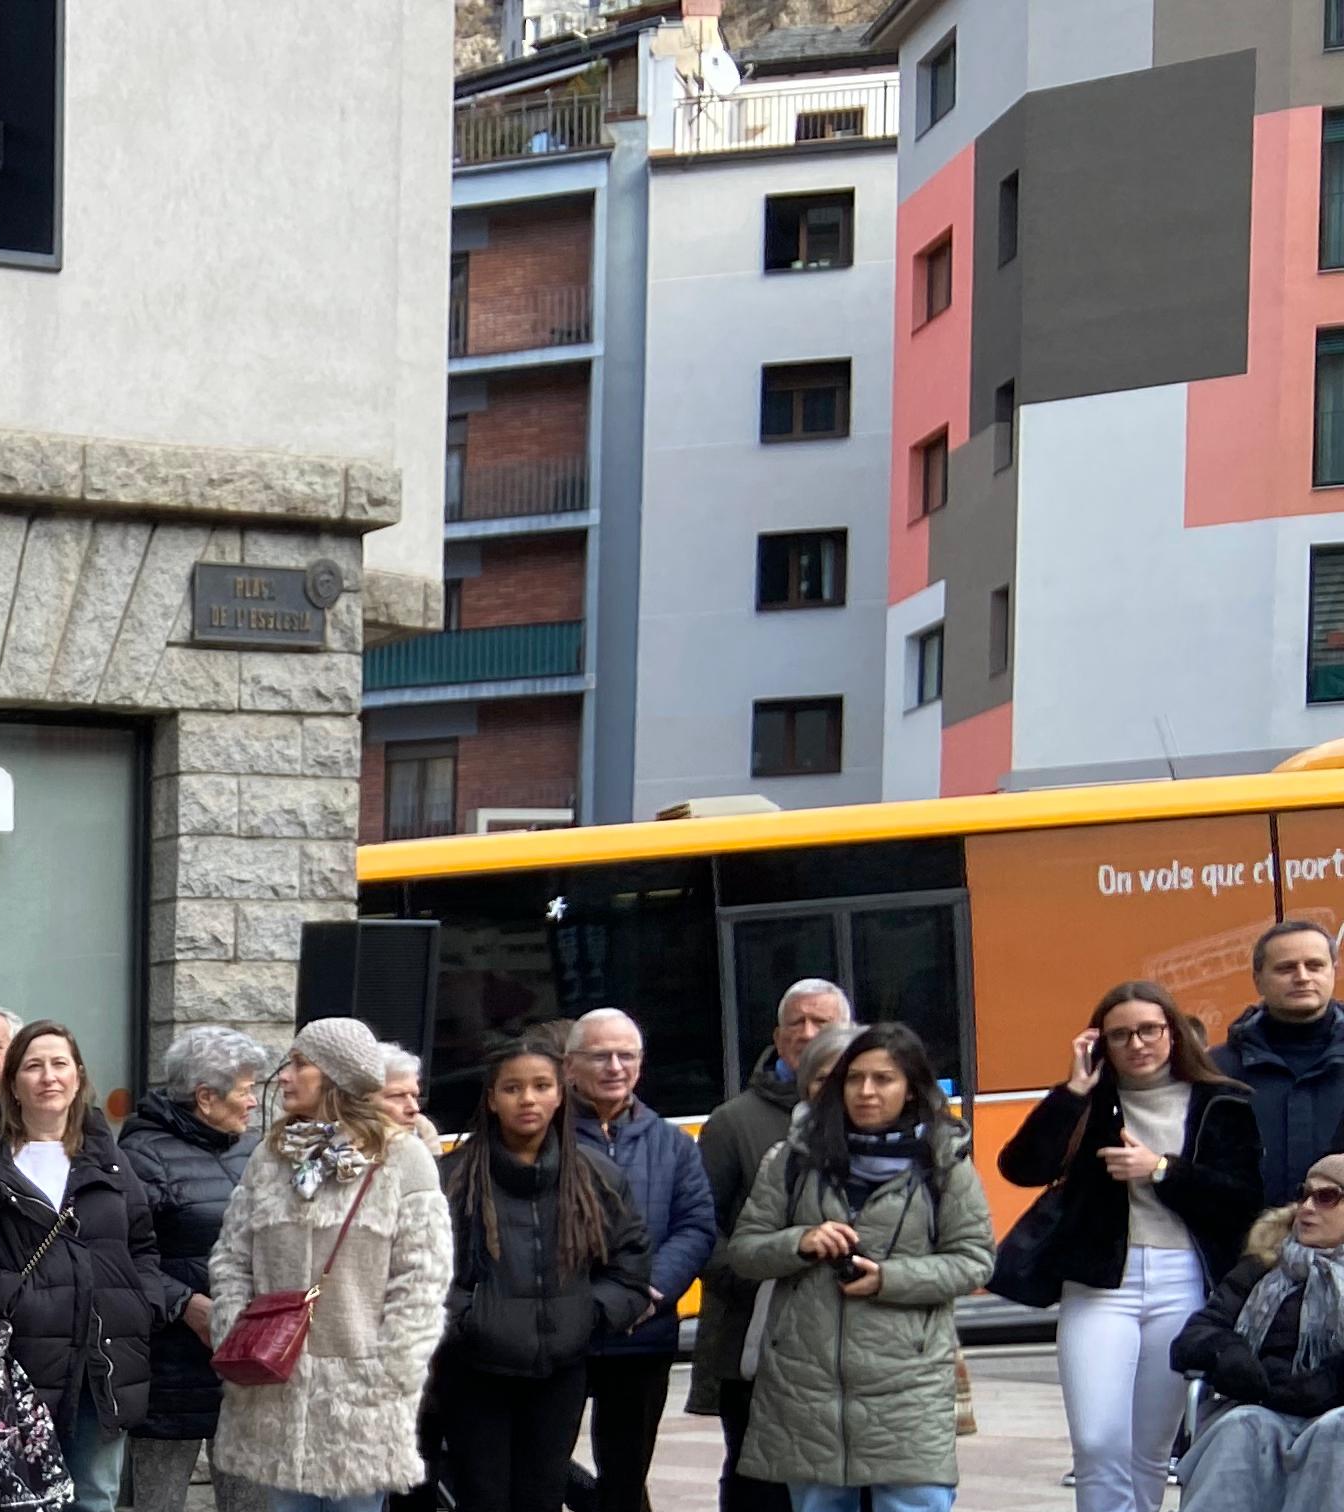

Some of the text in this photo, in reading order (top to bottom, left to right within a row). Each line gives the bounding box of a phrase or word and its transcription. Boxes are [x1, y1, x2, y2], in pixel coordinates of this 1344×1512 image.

[1098, 864, 1132, 896] On
[1139, 859, 1194, 892] vols
[1201, 862, 1245, 897] que
